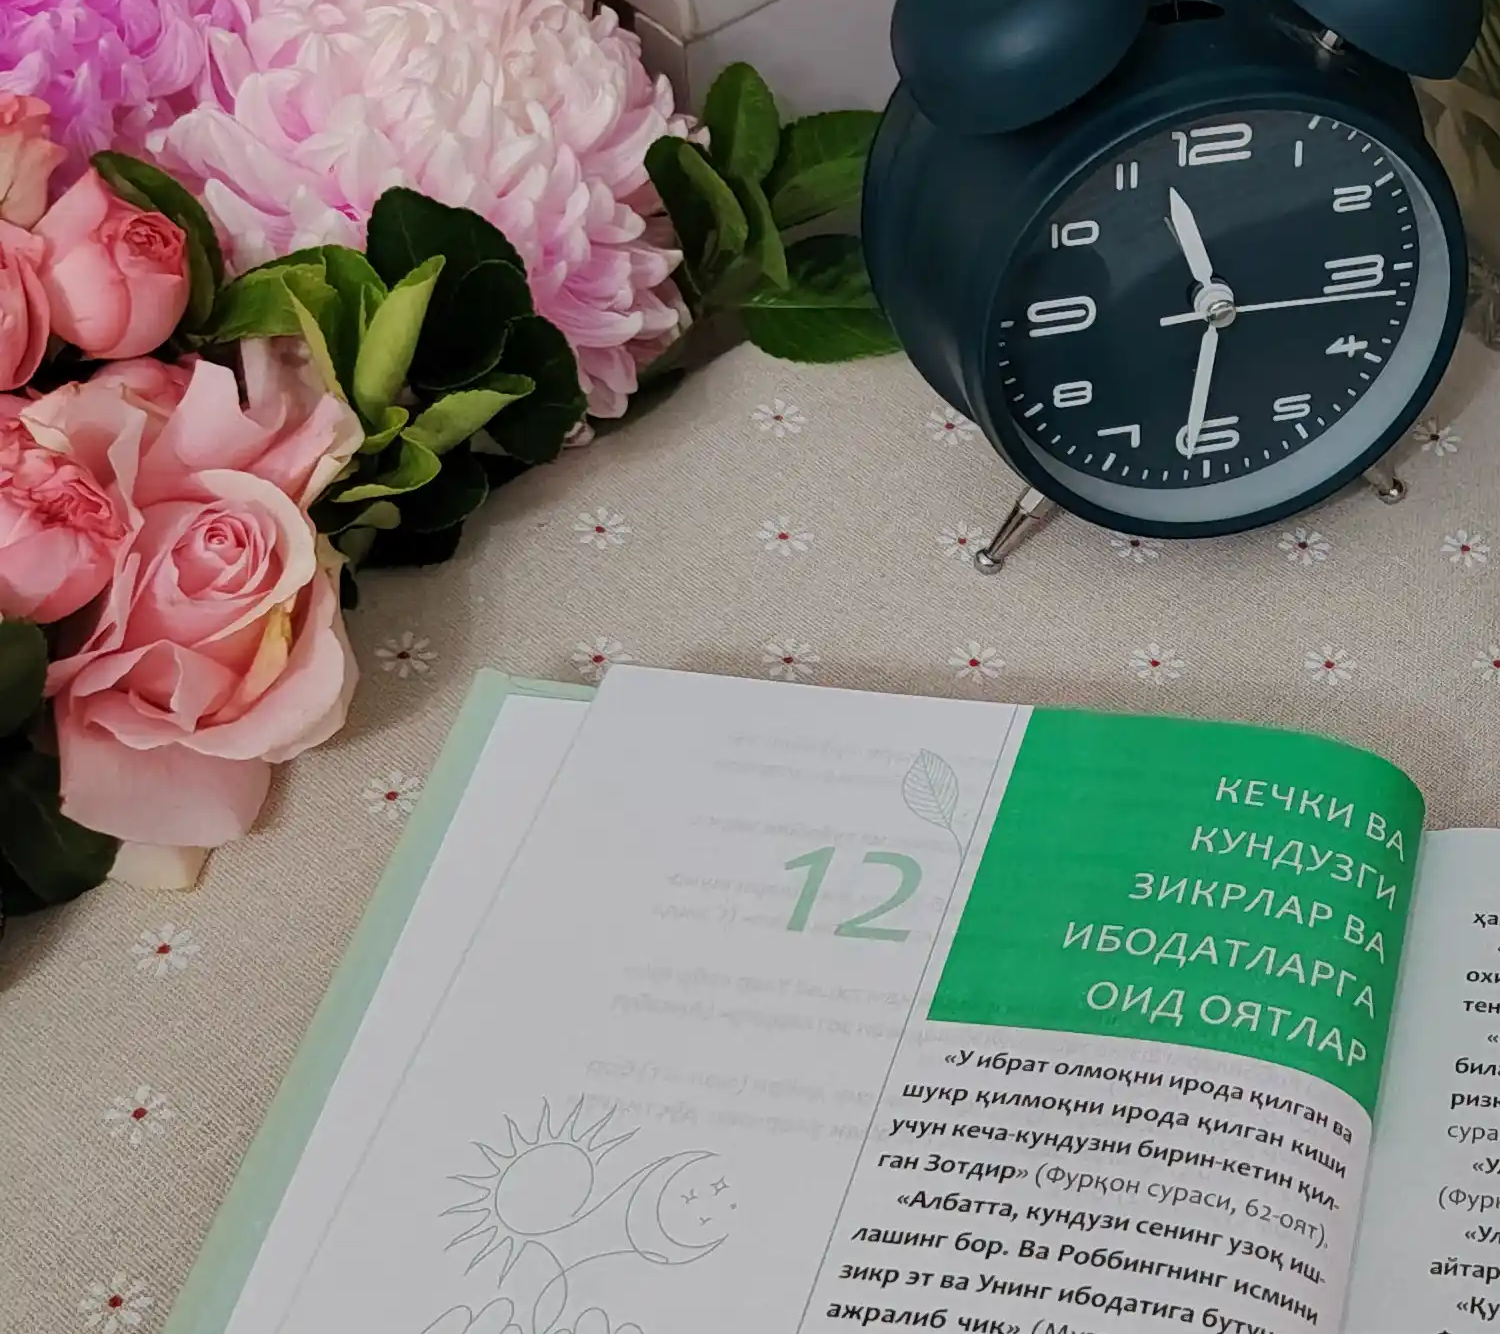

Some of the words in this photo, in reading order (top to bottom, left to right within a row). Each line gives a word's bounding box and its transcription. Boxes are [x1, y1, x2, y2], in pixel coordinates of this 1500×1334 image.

[1172, 123, 1252, 167] 12
[1294, 140, 1303, 168] 1
[1116, 162, 1138, 191] 11
[1333, 185, 1372, 212] 2
[1051, 220, 1099, 249] 10
[1324, 254, 1385, 294] 3
[1027, 296, 1096, 337] 9
[1325, 335, 1368, 357] 4
[1053, 380, 1092, 408] 8
[1273, 394, 1311, 421] 5
[1097, 424, 1140, 448] 7
[1176, 415, 1240, 457] 6
[1215, 777, 1355, 828] КЕЧКИ
[1366, 812, 1404, 861] ВА
[1191, 825, 1397, 910] КУНДУЗГИ
[784, 842, 923, 943] 12
[1128, 872, 1332, 927] ЗИКРЛАР
[1344, 914, 1385, 963] ВА
[1063, 921, 1374, 1013] ИБОДАТЛАРГА
[1086, 981, 1186, 1027] ОИД
[1200, 995, 1367, 1066] ОЯТЛАР
[945, 1050, 974, 1067] «У
[977, 1052, 1050, 1075] ибрат
[1054, 1062, 1163, 1087] олмоқни
[1169, 1076, 1243, 1102] ирода
[1250, 1091, 1328, 1128] қилган
[1333, 1121, 1352, 1144] ва
[902, 1084, 968, 1106] шукр
[975, 1090, 1104, 1116] қилмоқни
[1111, 1104, 1189, 1129] ирода
[1197, 1117, 1284, 1147] қилган
[1291, 1139, 1346, 1179] киши
[888, 1119, 947, 1139] учун
[952, 1124, 1131, 1155] кеча-кундузни
[1138, 1140, 1293, 1189] бирин-кетин
[878, 1154, 919, 1170] ган
[924, 1154, 1028, 1184] Зотдир»
[1147, 1183, 1236, 1216] сураси,
[1245, 1199, 1328, 1249] 62-оят).
[1430, 1257, 1500, 1285] айтар
